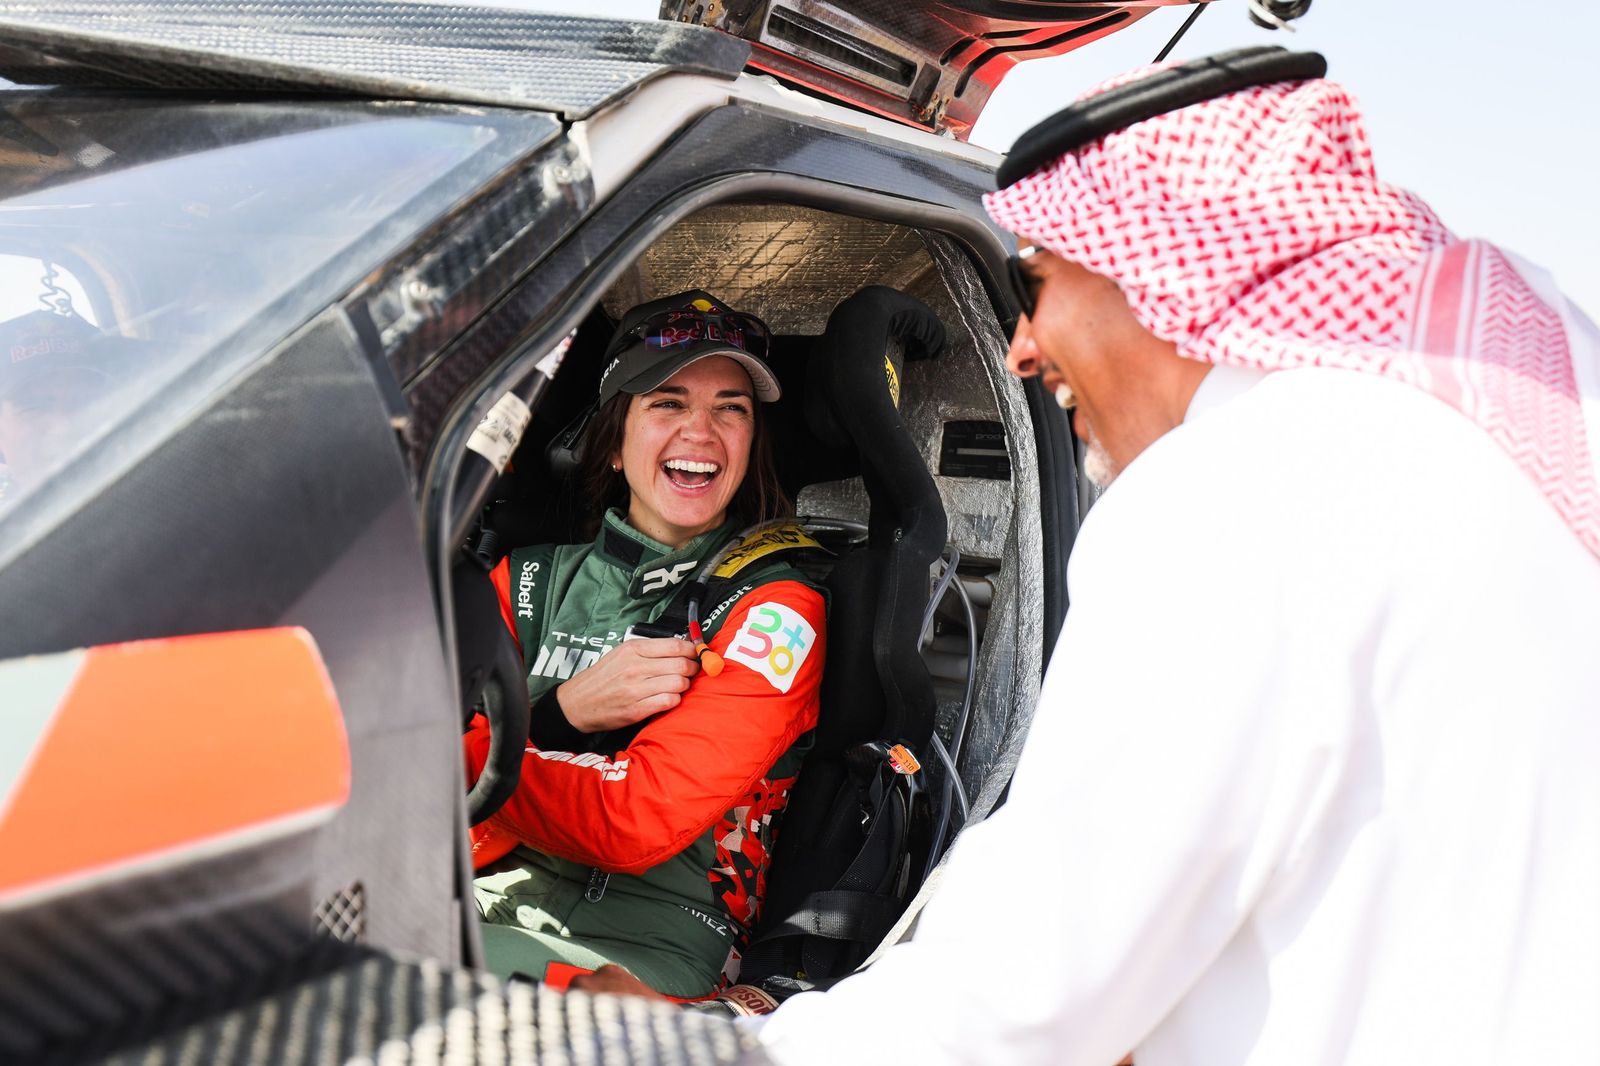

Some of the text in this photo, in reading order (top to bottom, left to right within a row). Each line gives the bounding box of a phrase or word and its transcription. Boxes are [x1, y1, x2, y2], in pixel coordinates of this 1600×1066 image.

[660, 320, 704, 348] Red
[518, 561, 540, 620] Sabelt
[551, 631, 604, 648] THE
